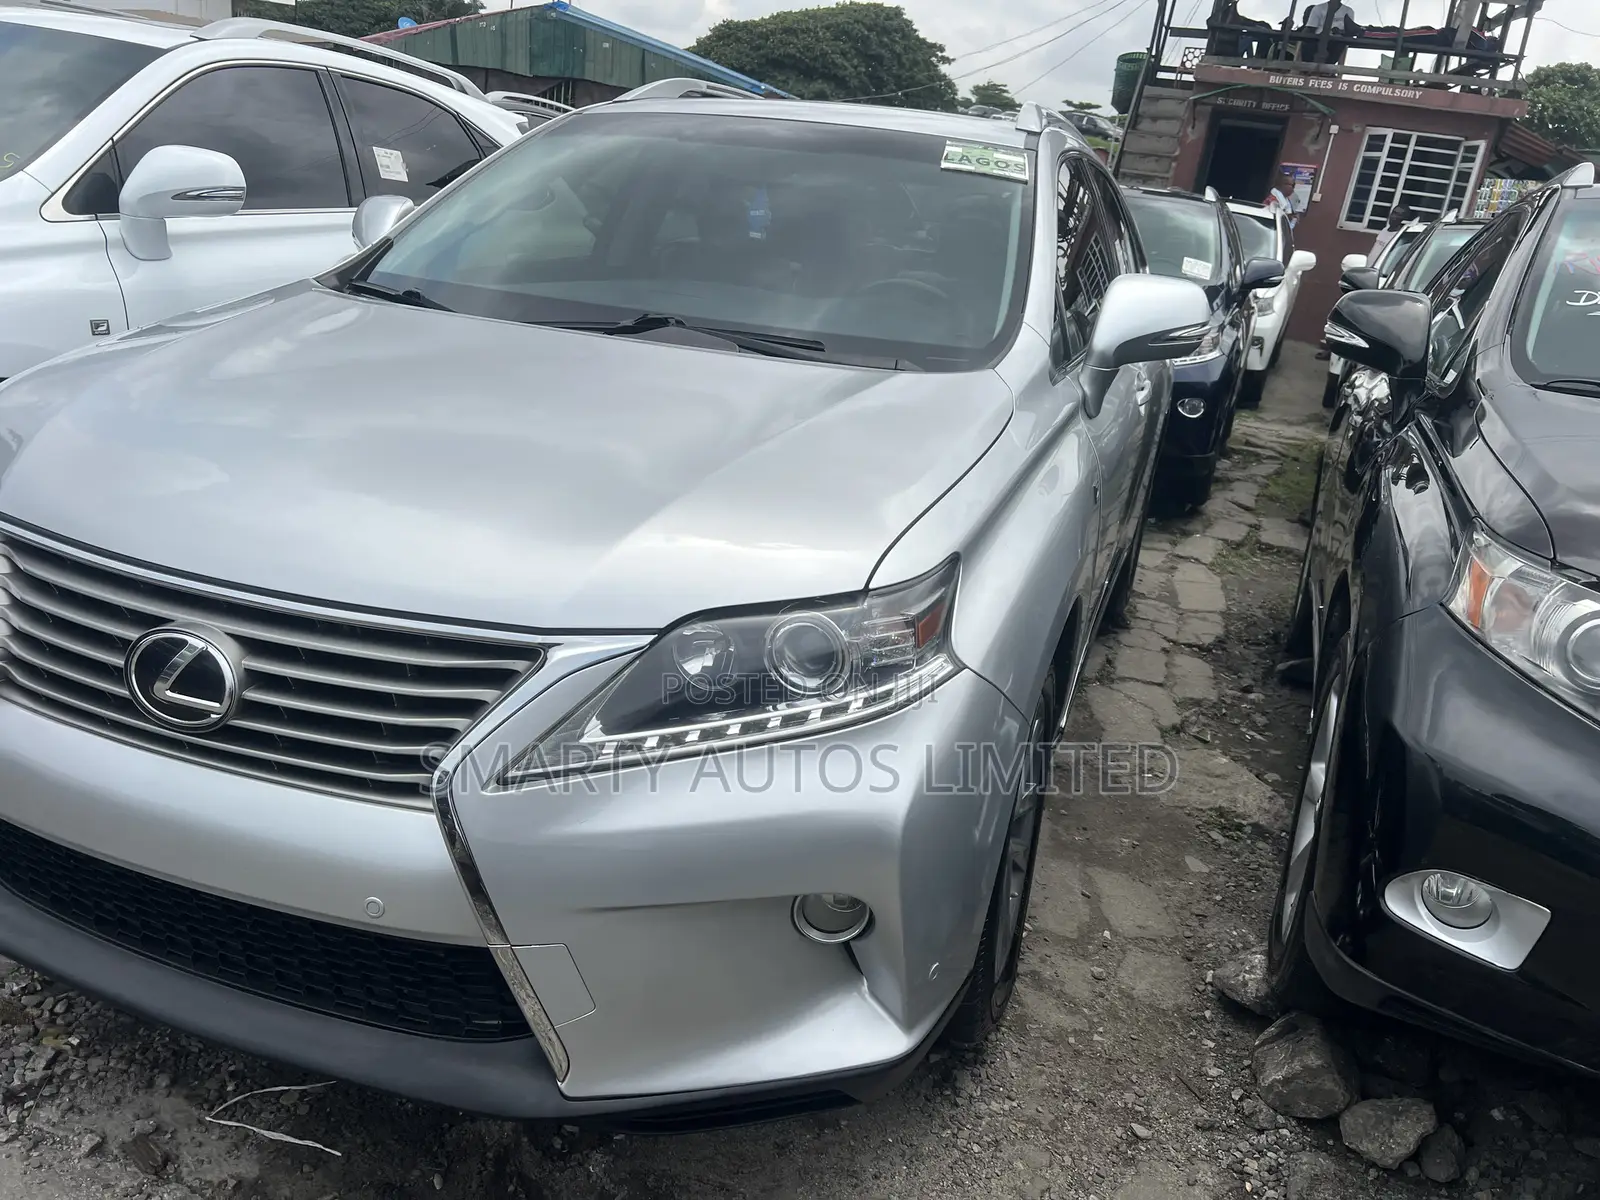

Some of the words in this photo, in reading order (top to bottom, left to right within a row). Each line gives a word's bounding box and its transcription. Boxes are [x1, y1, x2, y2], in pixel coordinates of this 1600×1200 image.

[1269, 75, 1304, 87] BUYERS
[1308, 79, 1333, 89] FEES
[1338, 82, 1348, 91] IS
[1353, 84, 1423, 99] COMPULSORY
[944, 152, 1024, 172] LAGOS
[1565, 290, 1600, 306] D
